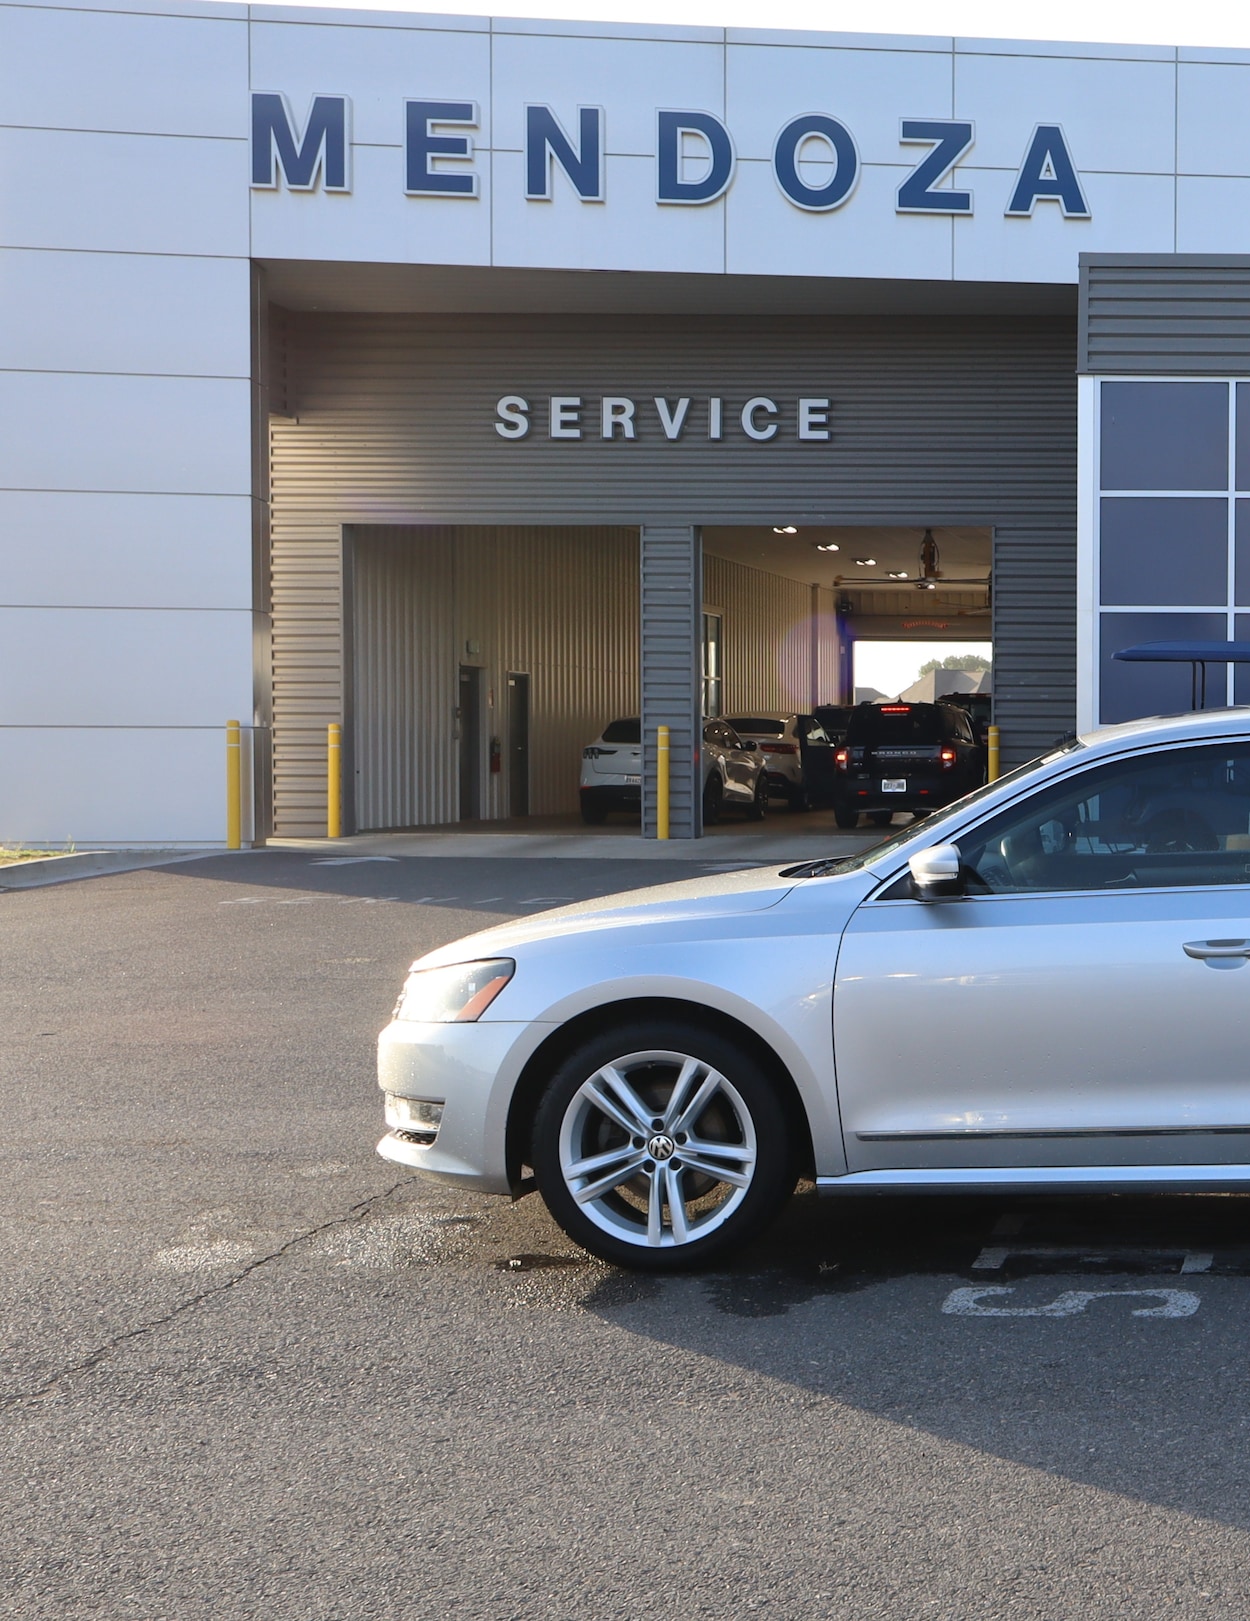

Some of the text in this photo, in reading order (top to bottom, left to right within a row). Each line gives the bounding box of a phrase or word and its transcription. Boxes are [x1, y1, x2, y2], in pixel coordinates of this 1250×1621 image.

[249, 91, 1092, 220] MENDOZA
[494, 394, 834, 443] SERVICE
[217, 894, 576, 905] SERVIC
